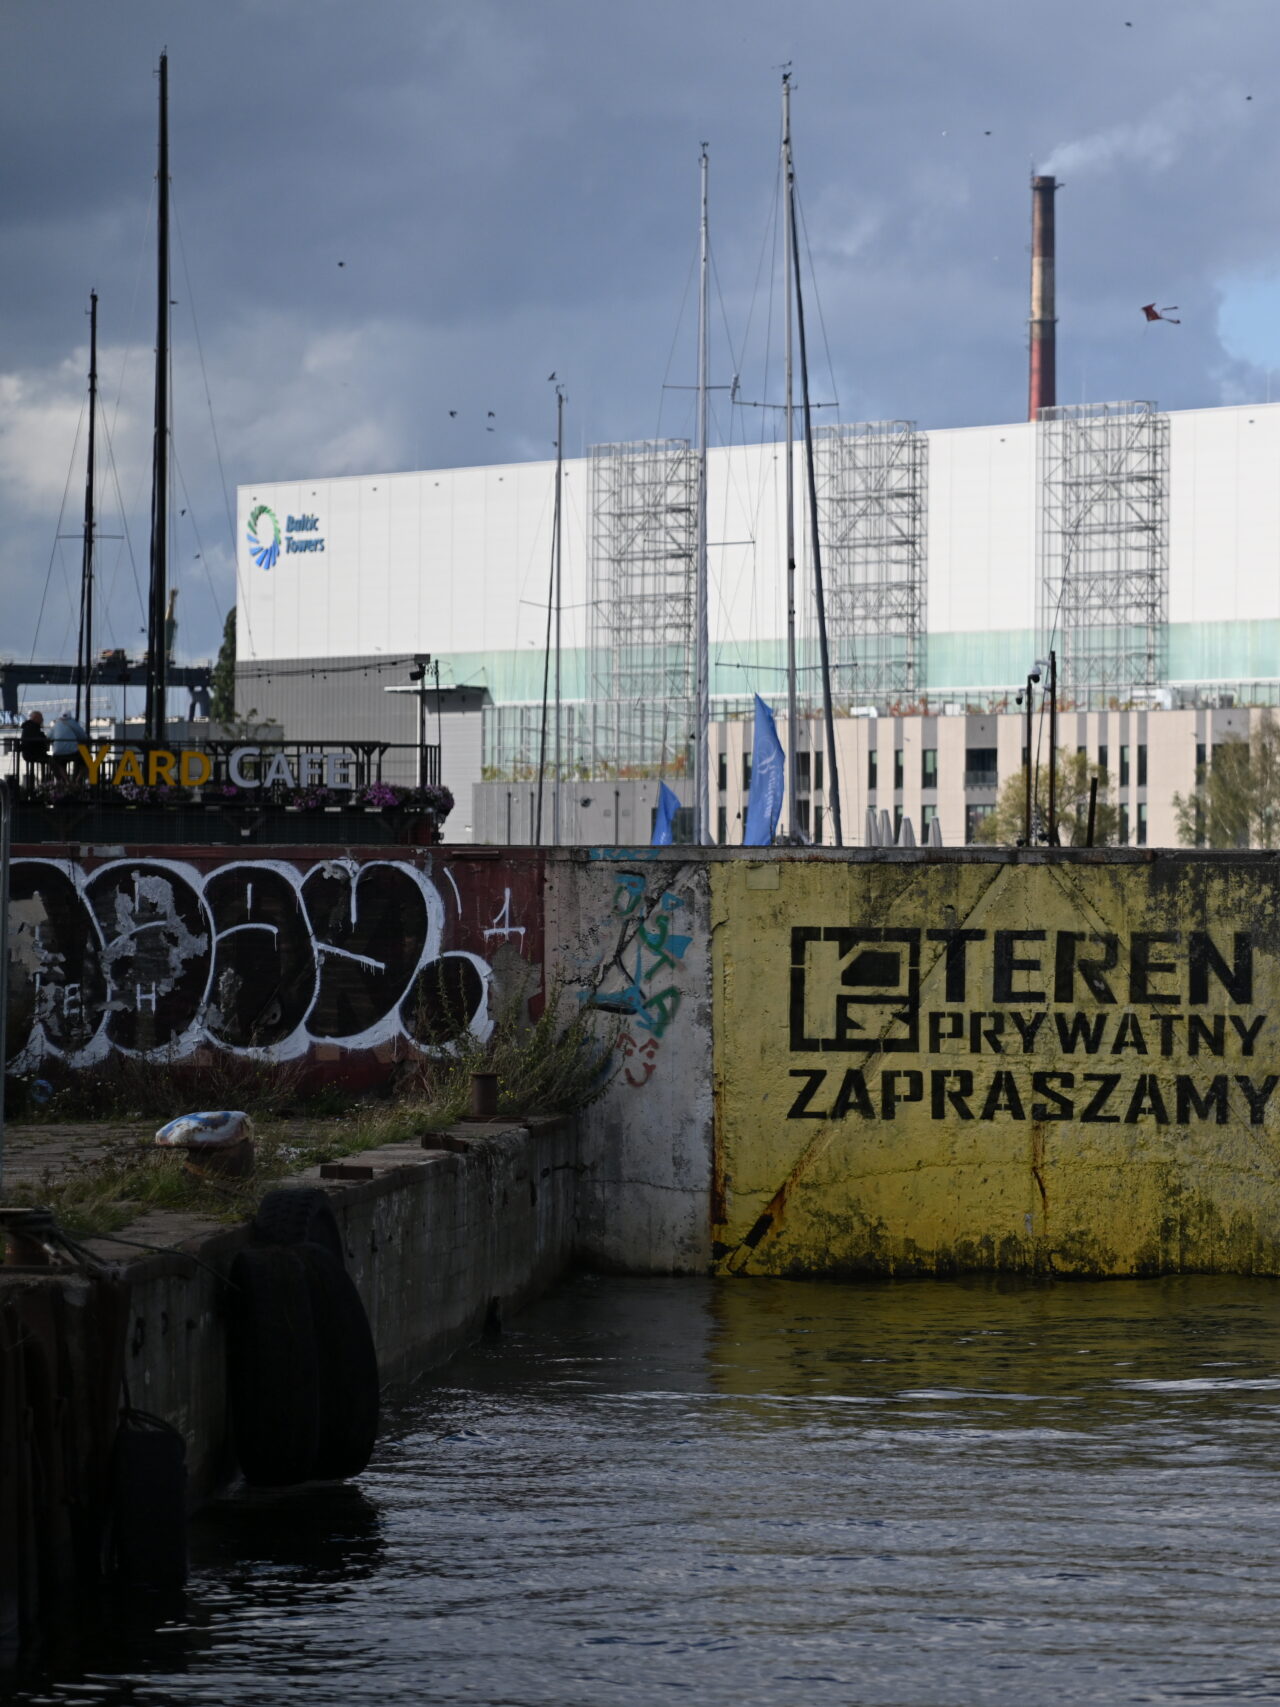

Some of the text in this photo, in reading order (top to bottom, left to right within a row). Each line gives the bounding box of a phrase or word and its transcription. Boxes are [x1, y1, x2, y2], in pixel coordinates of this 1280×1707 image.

[285, 536, 325, 554] Towers
[286, 514, 319, 533] Baltic
[78, 744, 352, 790] YARD CAFE
[926, 928, 1254, 1006] TEREN
[928, 1011, 1267, 1057] PRYWATNY
[787, 1069, 1280, 1126] ZAPRASZAMY
